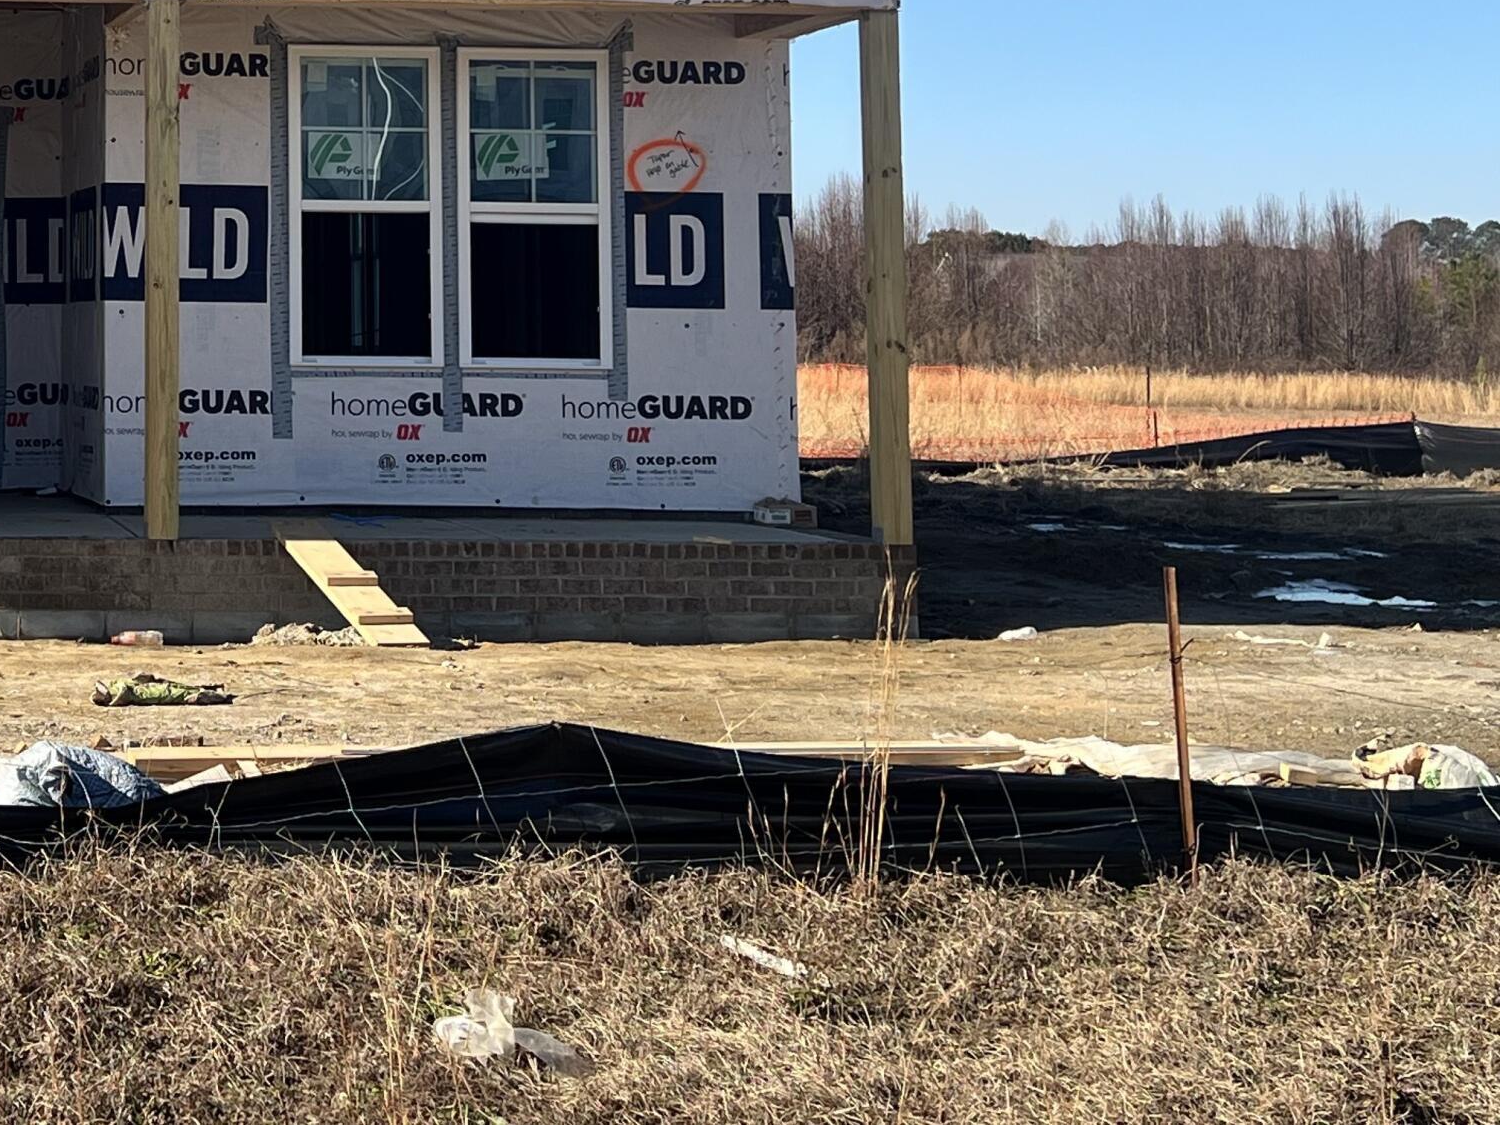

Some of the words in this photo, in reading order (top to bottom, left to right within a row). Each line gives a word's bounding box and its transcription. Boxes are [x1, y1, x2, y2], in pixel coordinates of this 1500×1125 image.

[102, 205, 250, 280] WLD
[633, 213, 706, 287] LD
[562, 394, 753, 421] homeGUARD
[379, 429, 392, 441] by
[396, 424, 422, 441] OX
[610, 431, 623, 444] by
[626, 427, 651, 443] OX
[406, 453, 487, 465] oxep.com
[636, 455, 717, 468] oxep.com
